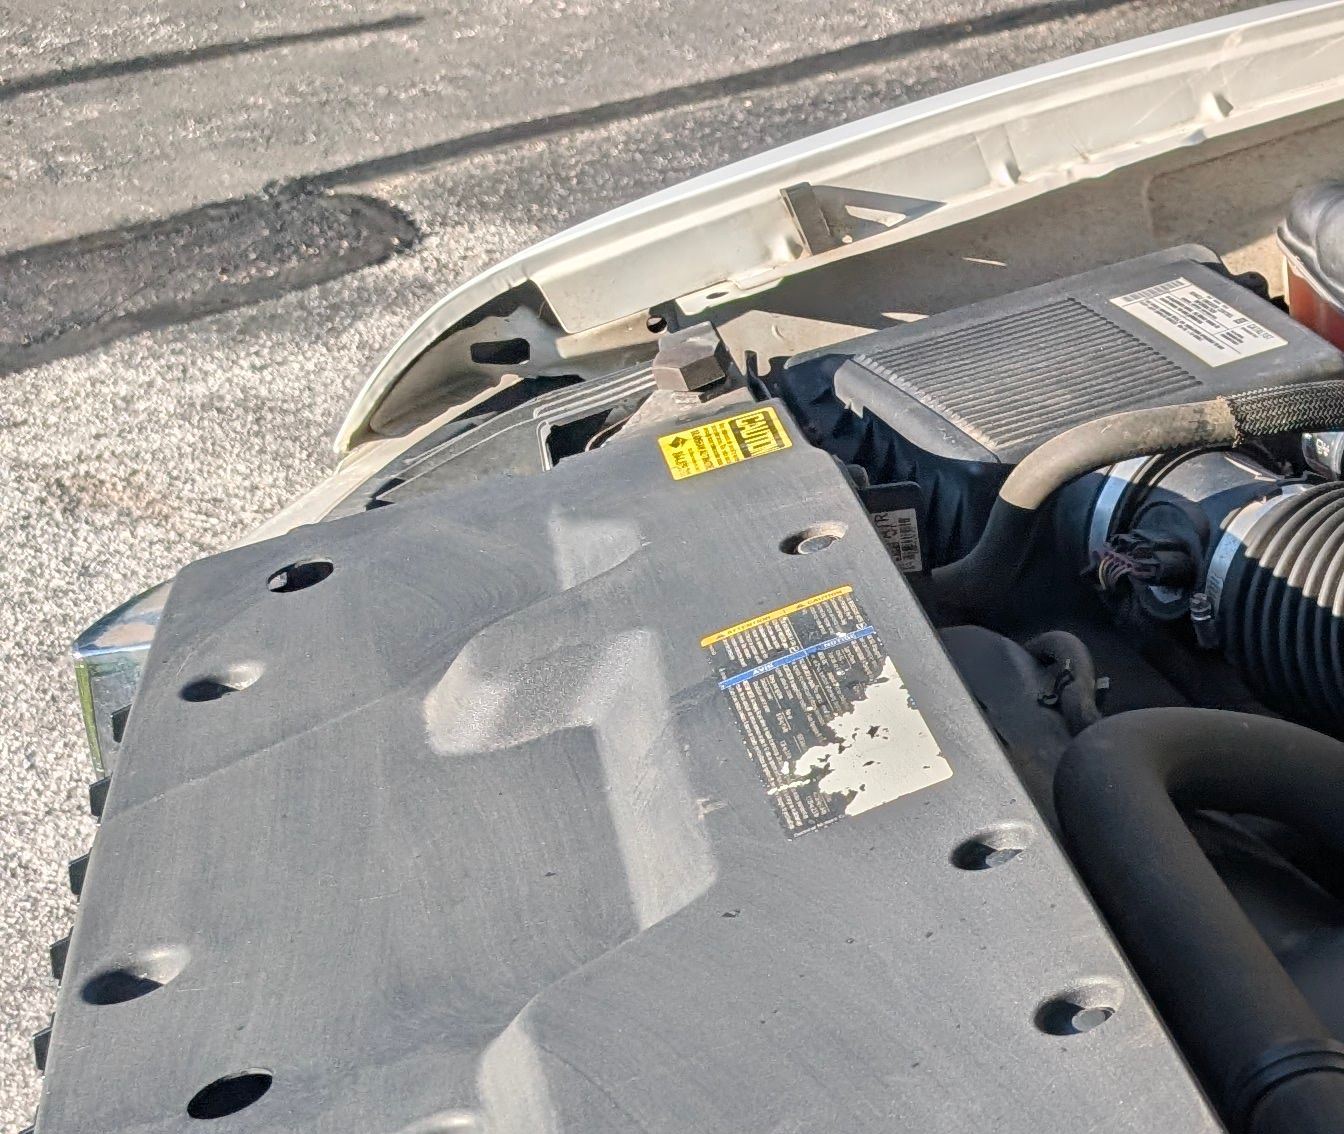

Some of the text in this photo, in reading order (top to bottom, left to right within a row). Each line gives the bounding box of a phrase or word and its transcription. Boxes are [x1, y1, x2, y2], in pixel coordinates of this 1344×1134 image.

[735, 412, 778, 457] CAUTION
[807, 590, 843, 605] CAUTION
[727, 616, 771, 635] ATTENTION
[752, 663, 774, 676] AVIS
